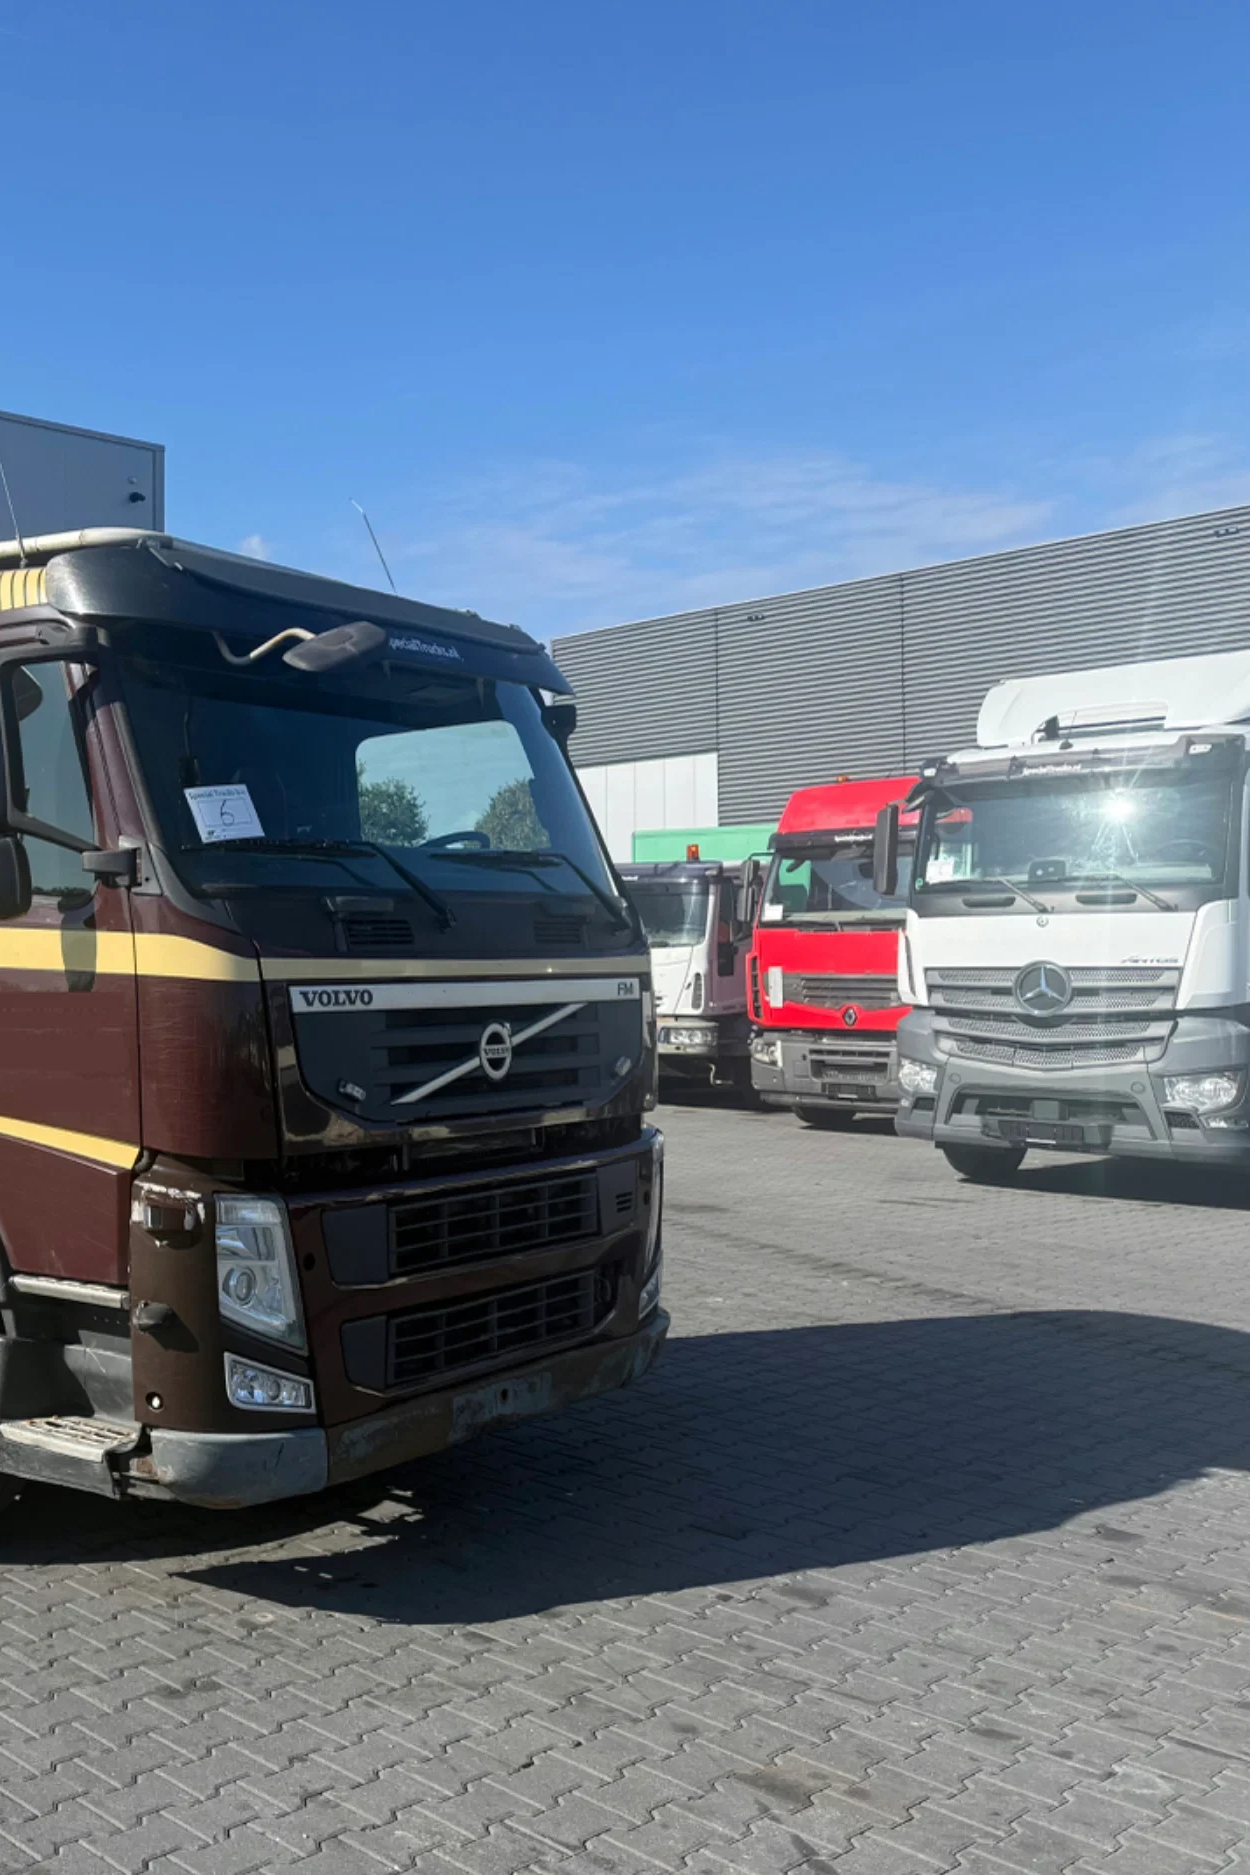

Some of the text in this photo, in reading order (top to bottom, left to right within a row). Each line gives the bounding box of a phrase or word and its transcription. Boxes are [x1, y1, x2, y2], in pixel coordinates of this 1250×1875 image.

[220, 799, 235, 827] 6
[617, 981, 634, 996] FM
[299, 989, 373, 1007] VOLVO
